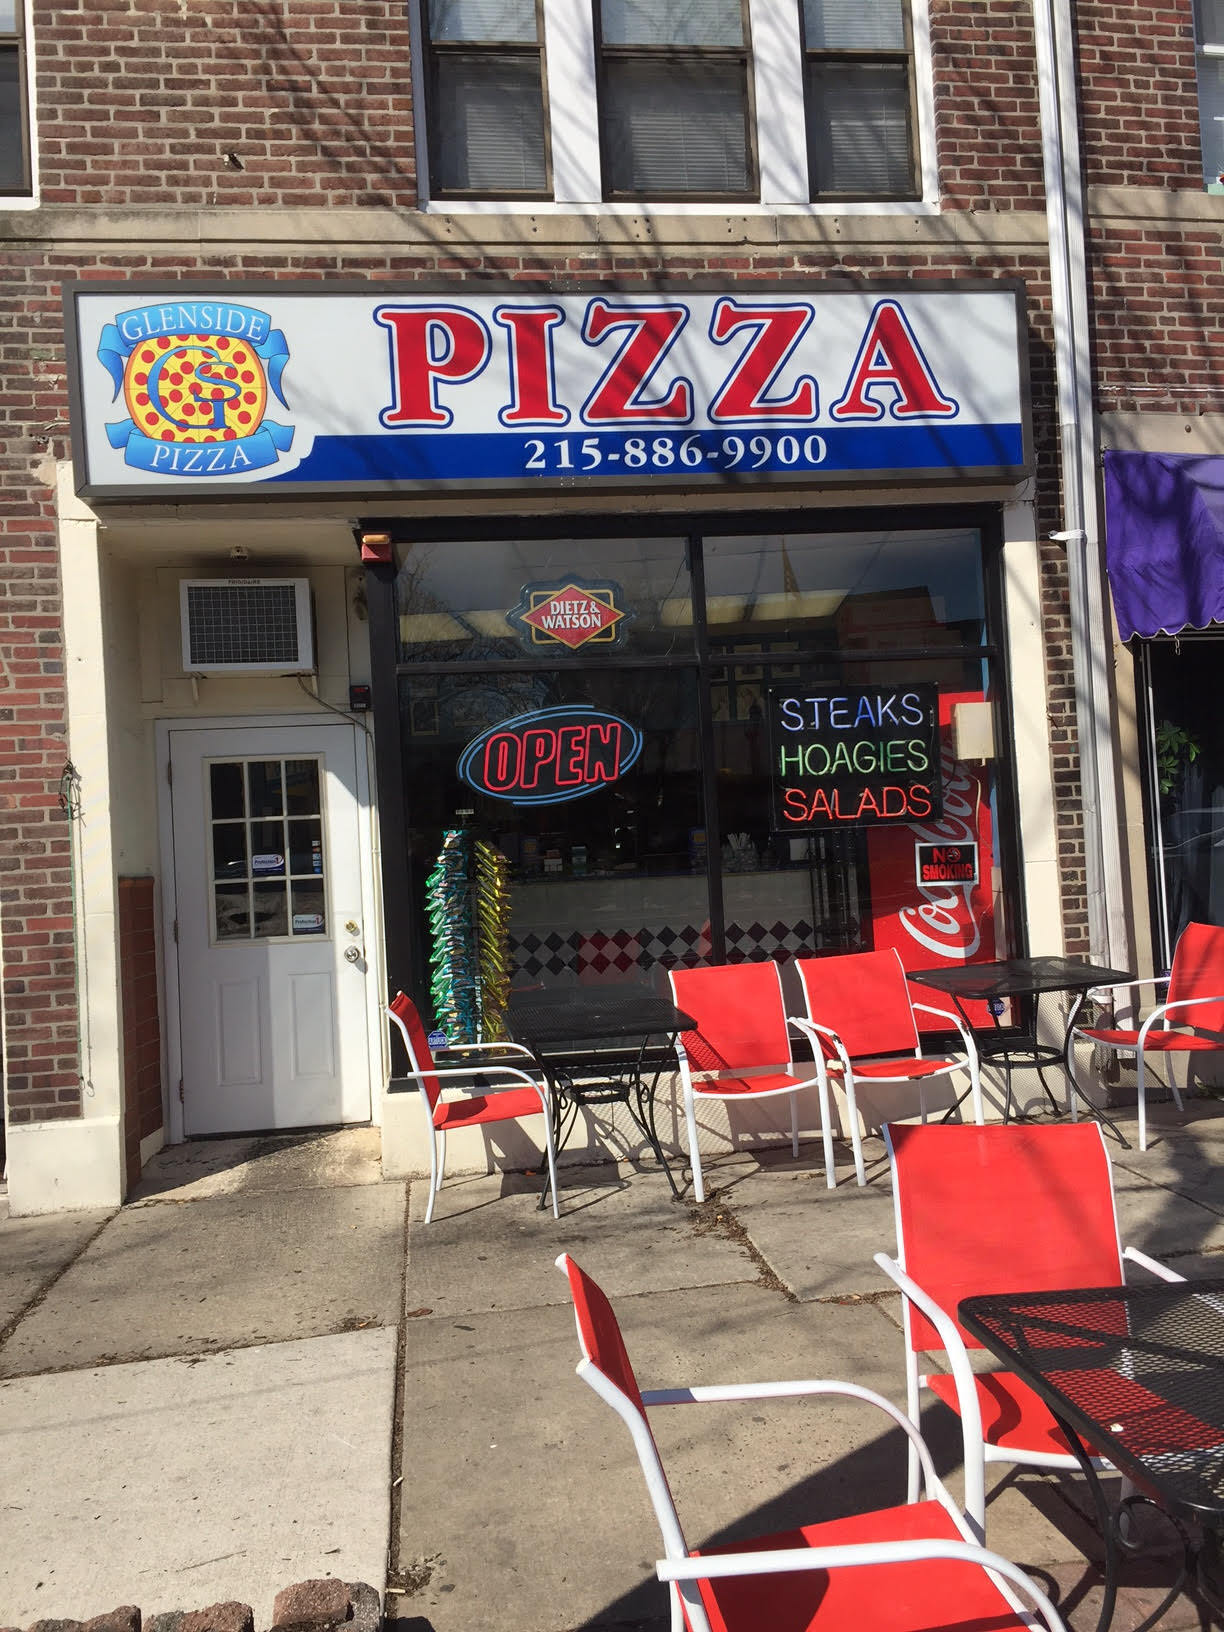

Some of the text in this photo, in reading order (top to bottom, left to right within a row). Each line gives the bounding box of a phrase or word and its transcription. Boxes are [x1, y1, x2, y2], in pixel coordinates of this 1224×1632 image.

[122, 305, 264, 341] GLENSIDE
[373, 297, 959, 431] PIZZA
[150, 444, 252, 472] PIZZA
[524, 434, 828, 470] 215-886-9900
[541, 614, 602, 629] WATSON
[550, 600, 601, 615] DIETZ &
[780, 693, 923, 731] STEAKS
[483, 723, 621, 791] OPEN
[780, 739, 928, 776] HOAGIES
[783, 785, 932, 821] SALADS
[922, 863, 973, 880] SMOKING
[932, 847, 961, 864] NO
